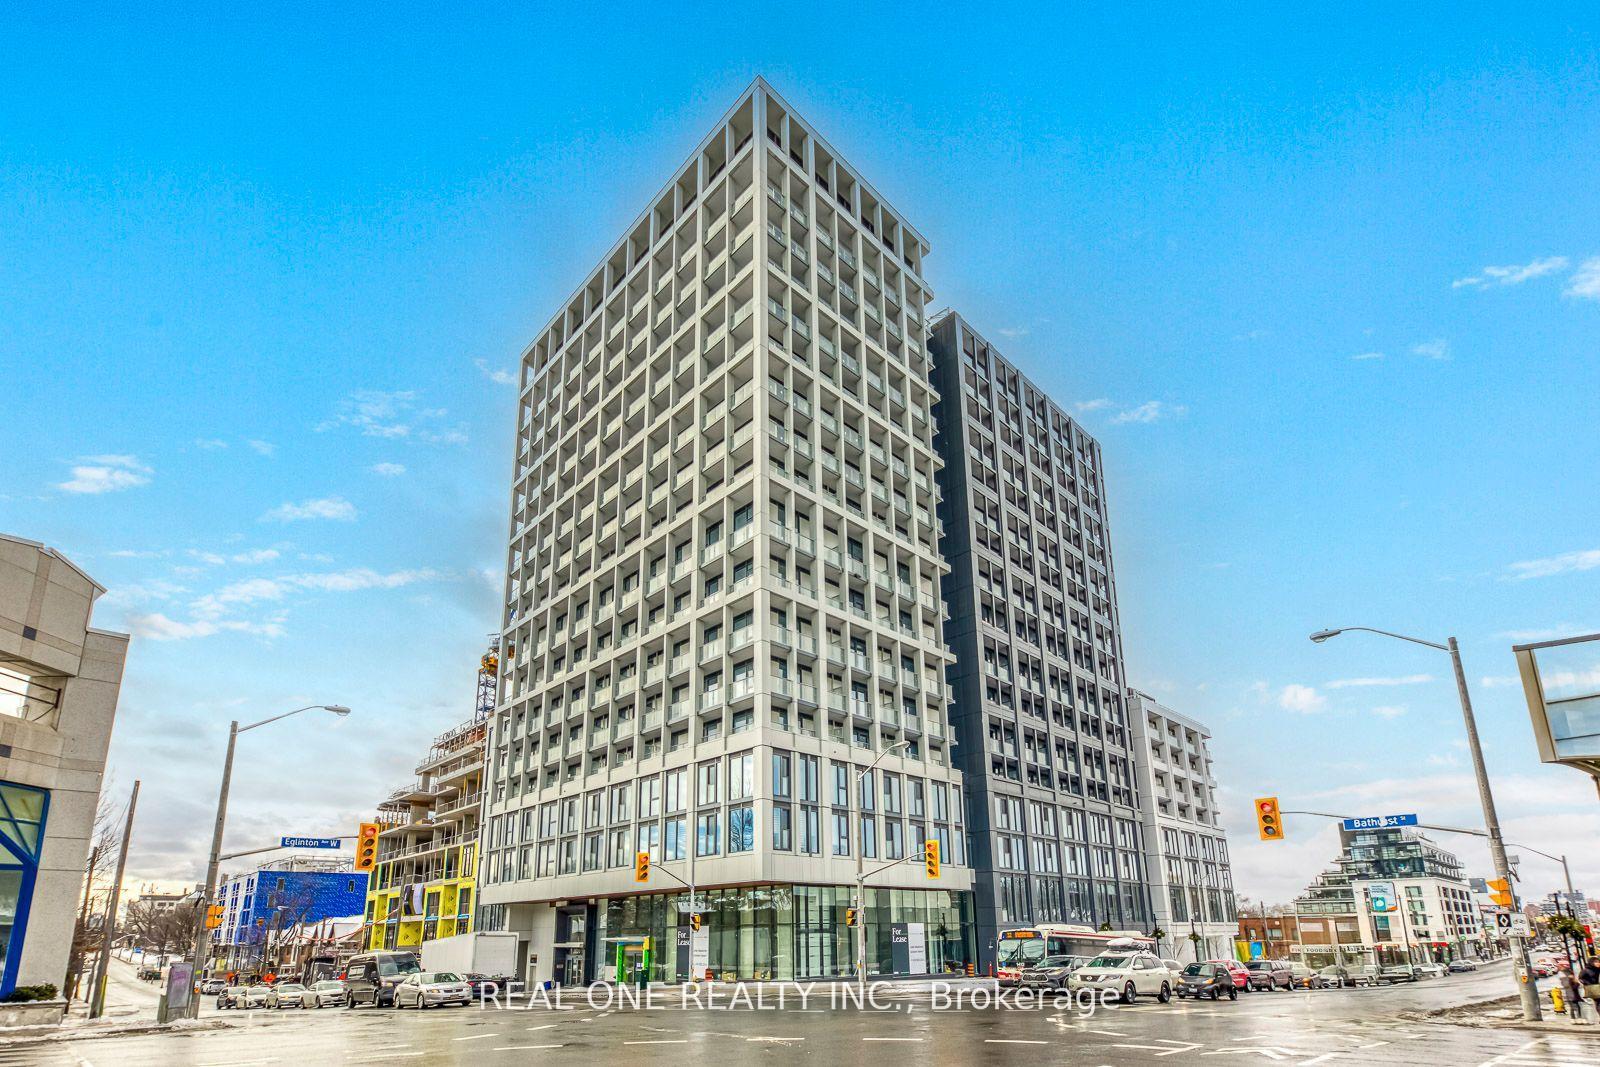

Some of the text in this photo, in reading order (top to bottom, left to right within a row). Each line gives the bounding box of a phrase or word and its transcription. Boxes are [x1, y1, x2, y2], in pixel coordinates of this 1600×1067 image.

[1353, 816, 1398, 828] Bathust
[285, 838, 319, 848] Eglinton
[330, 839, 338, 847] W
[677, 930, 687, 939] For
[892, 927, 902, 936] For
[892, 935, 908, 943] Lease
